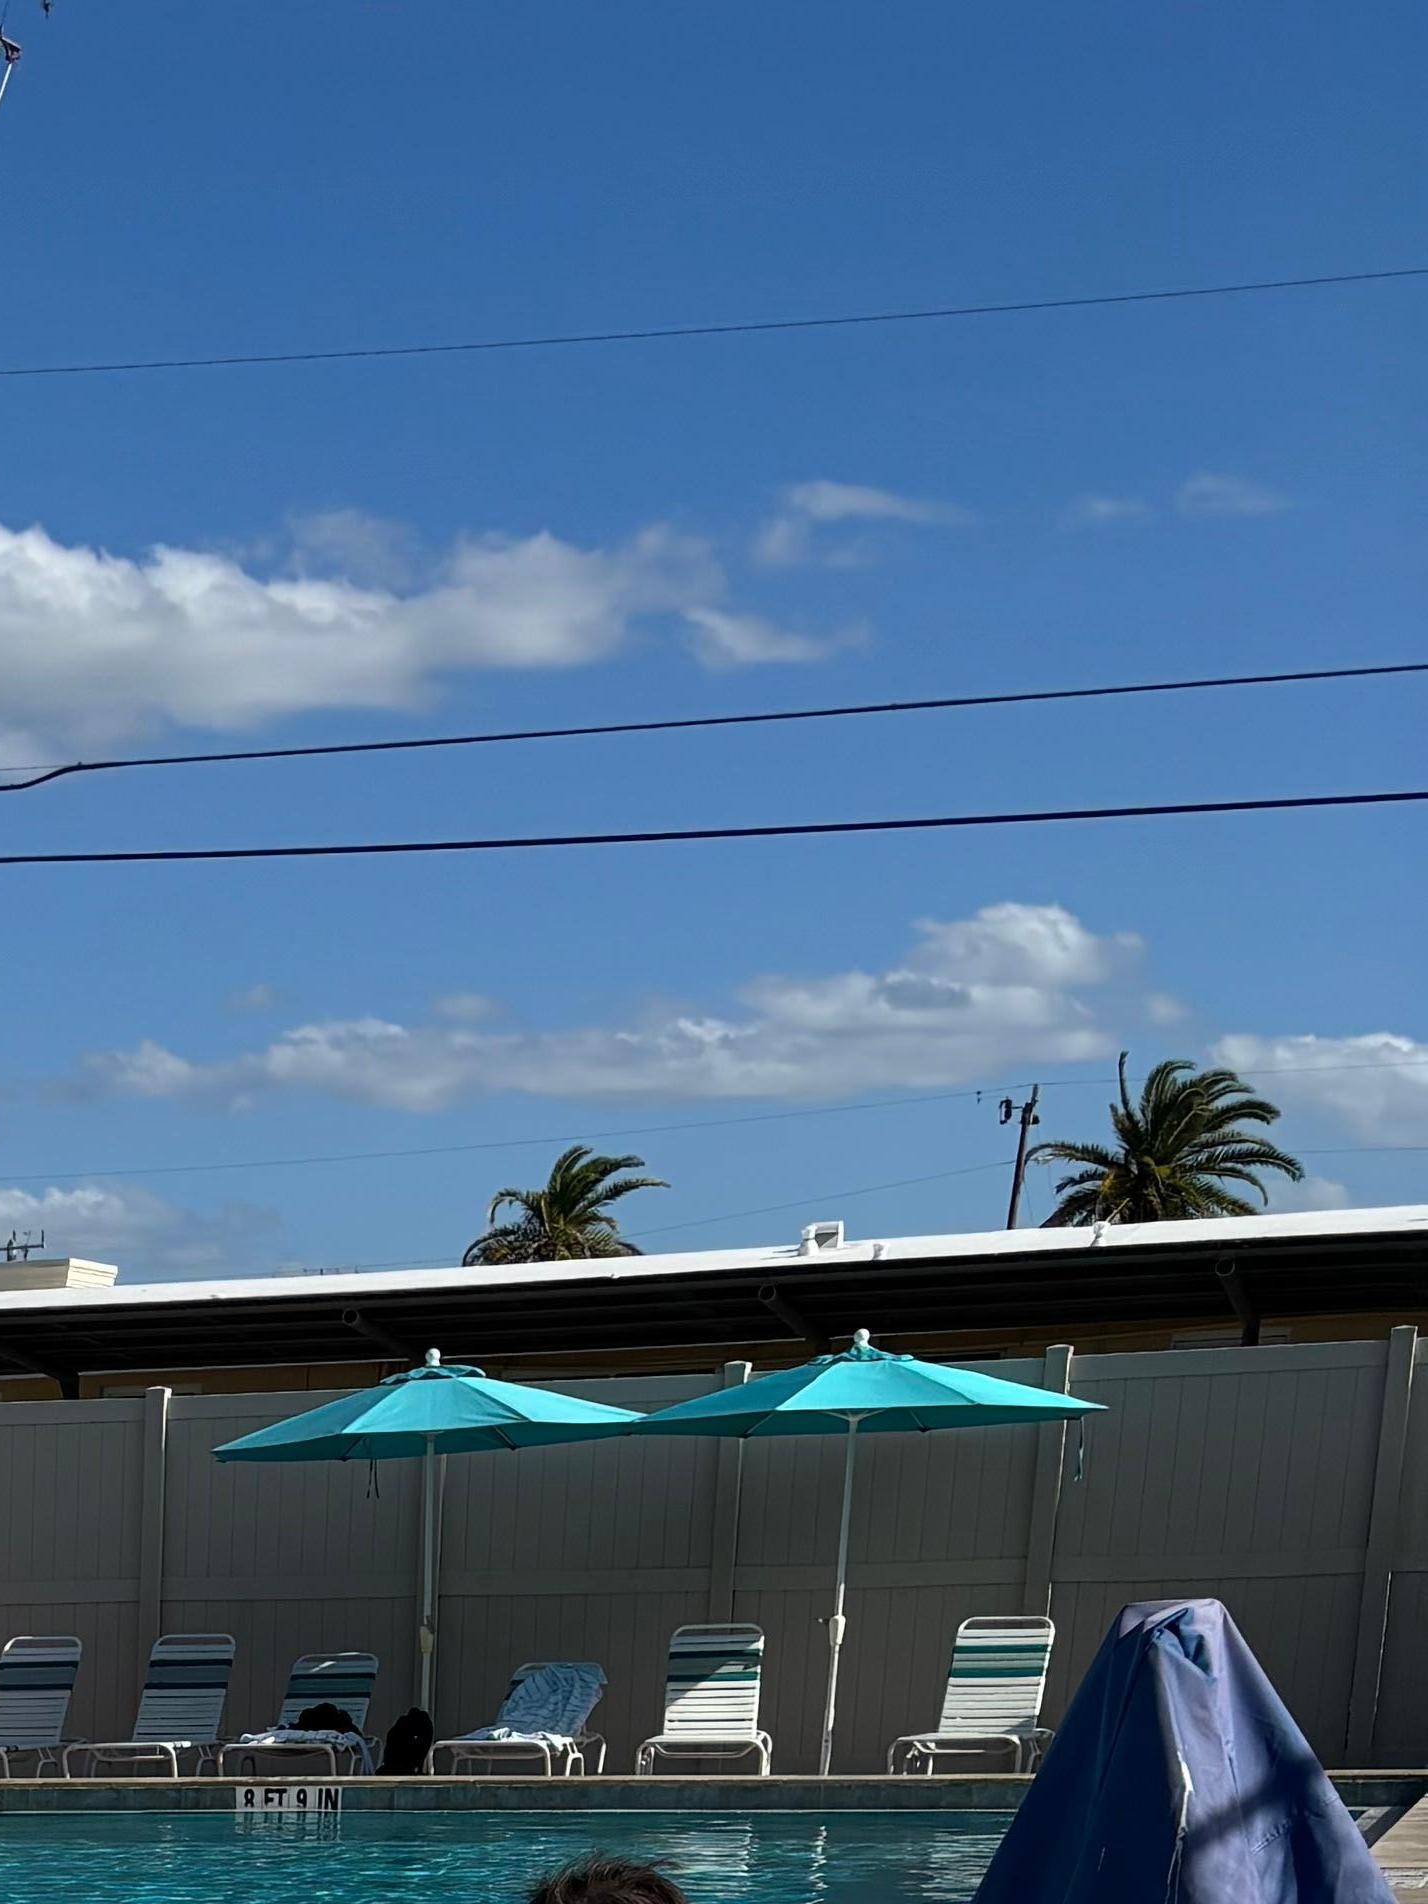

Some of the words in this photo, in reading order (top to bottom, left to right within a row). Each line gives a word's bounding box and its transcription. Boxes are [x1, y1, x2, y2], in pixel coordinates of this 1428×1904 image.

[244, 1788, 255, 1810] 8
[264, 1787, 288, 1809] FT
[296, 1788, 308, 1810] 9
[318, 1787, 340, 1811] IN
